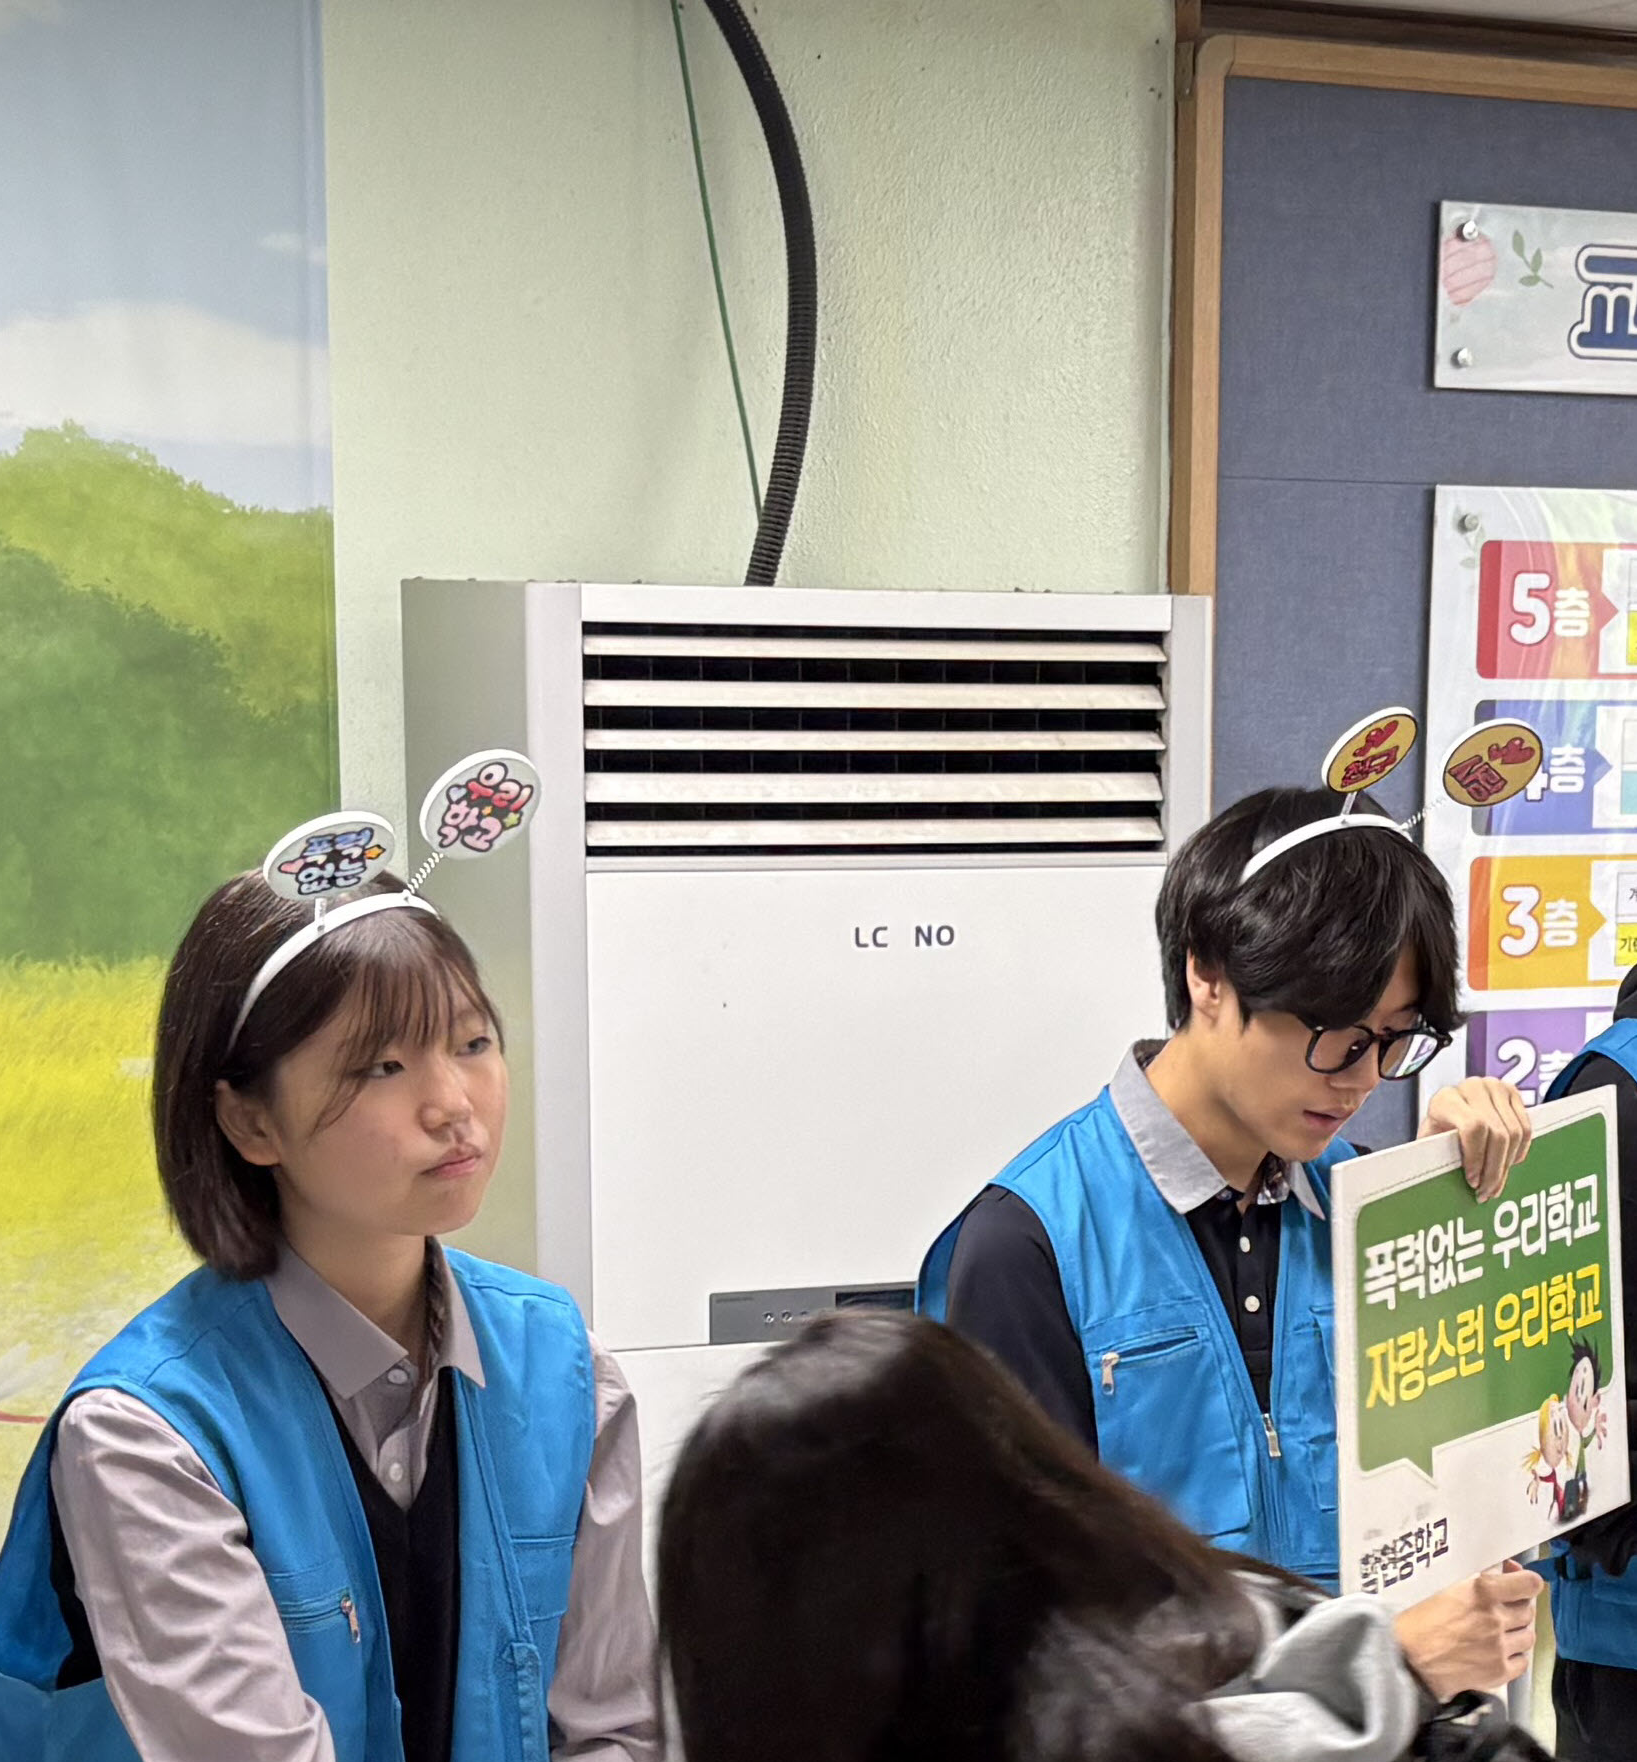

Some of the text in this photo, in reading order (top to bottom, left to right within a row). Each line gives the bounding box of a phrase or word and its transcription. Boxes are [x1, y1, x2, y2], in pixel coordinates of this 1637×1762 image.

[1509, 572, 1590, 645] 5층
[464, 761, 534, 812] 우리
[436, 800, 504, 853] 학교
[1499, 884, 1579, 959] 3층
[1363, 1172, 1601, 1311] 폭력없는 우리학교
[1365, 1262, 1602, 1409] 자랑스런 우리학교
